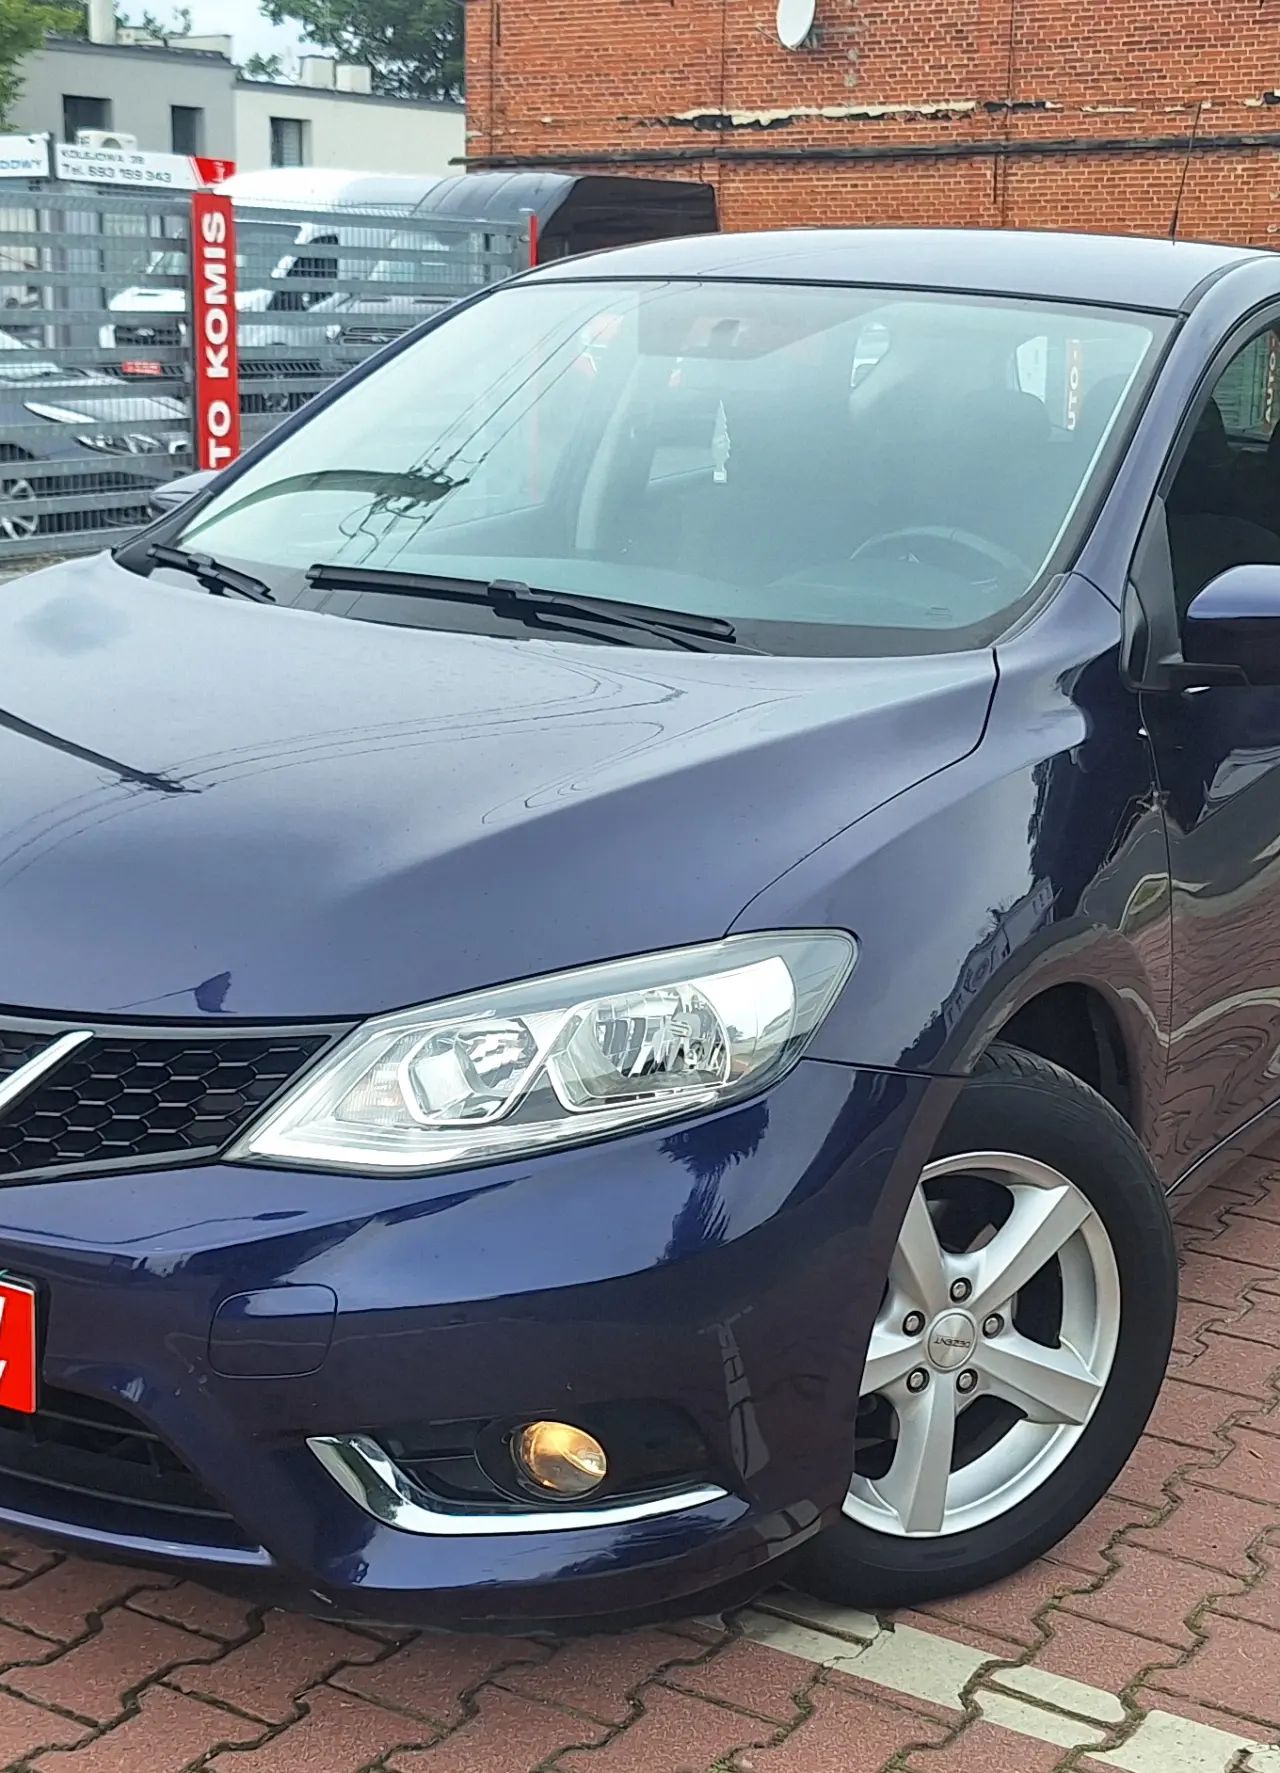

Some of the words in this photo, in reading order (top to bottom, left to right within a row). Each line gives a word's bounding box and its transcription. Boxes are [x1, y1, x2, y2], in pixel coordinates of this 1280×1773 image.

[202, 211, 230, 378] KOMIS
[208, 400, 232, 469] TO
[933, 1336, 971, 1349] DEZENT
